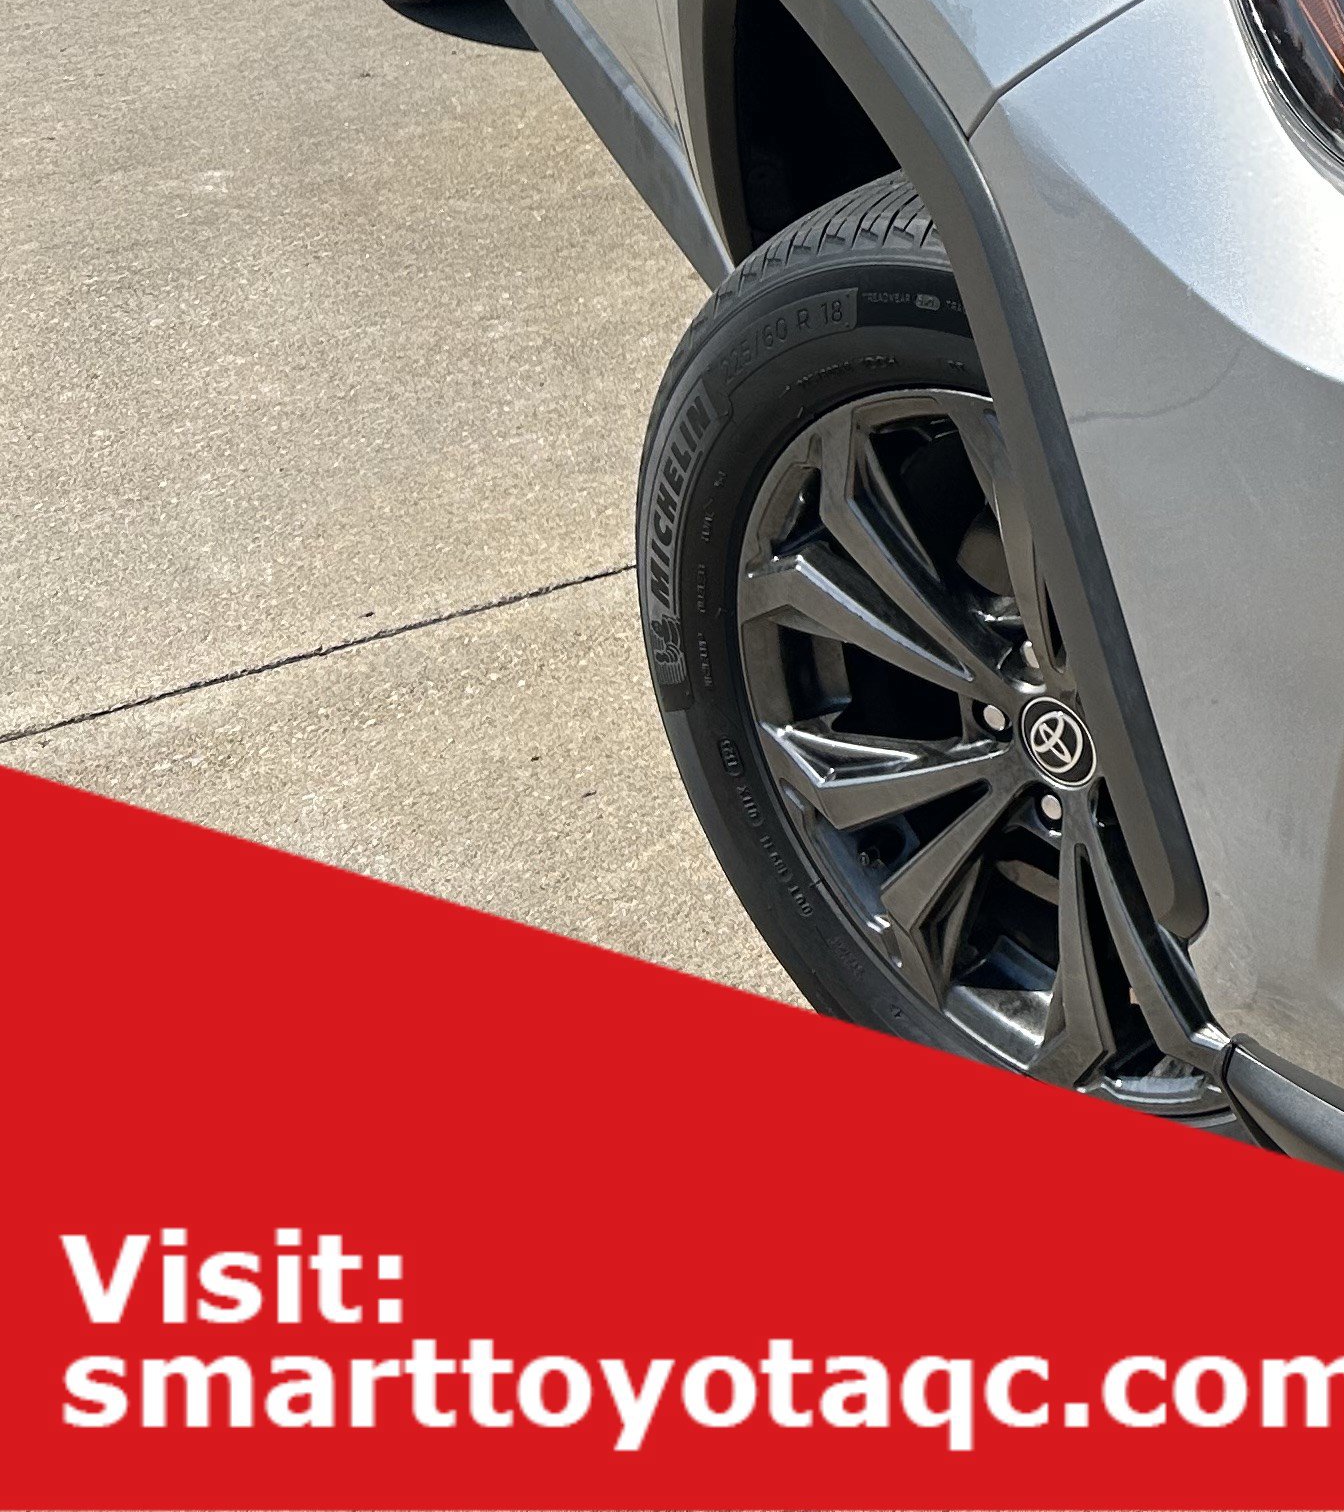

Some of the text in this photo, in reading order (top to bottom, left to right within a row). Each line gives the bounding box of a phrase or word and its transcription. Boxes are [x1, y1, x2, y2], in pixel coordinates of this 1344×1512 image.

[796, 309, 812, 330] R
[819, 299, 844, 327] 18
[650, 395, 712, 610] MICHELIN
